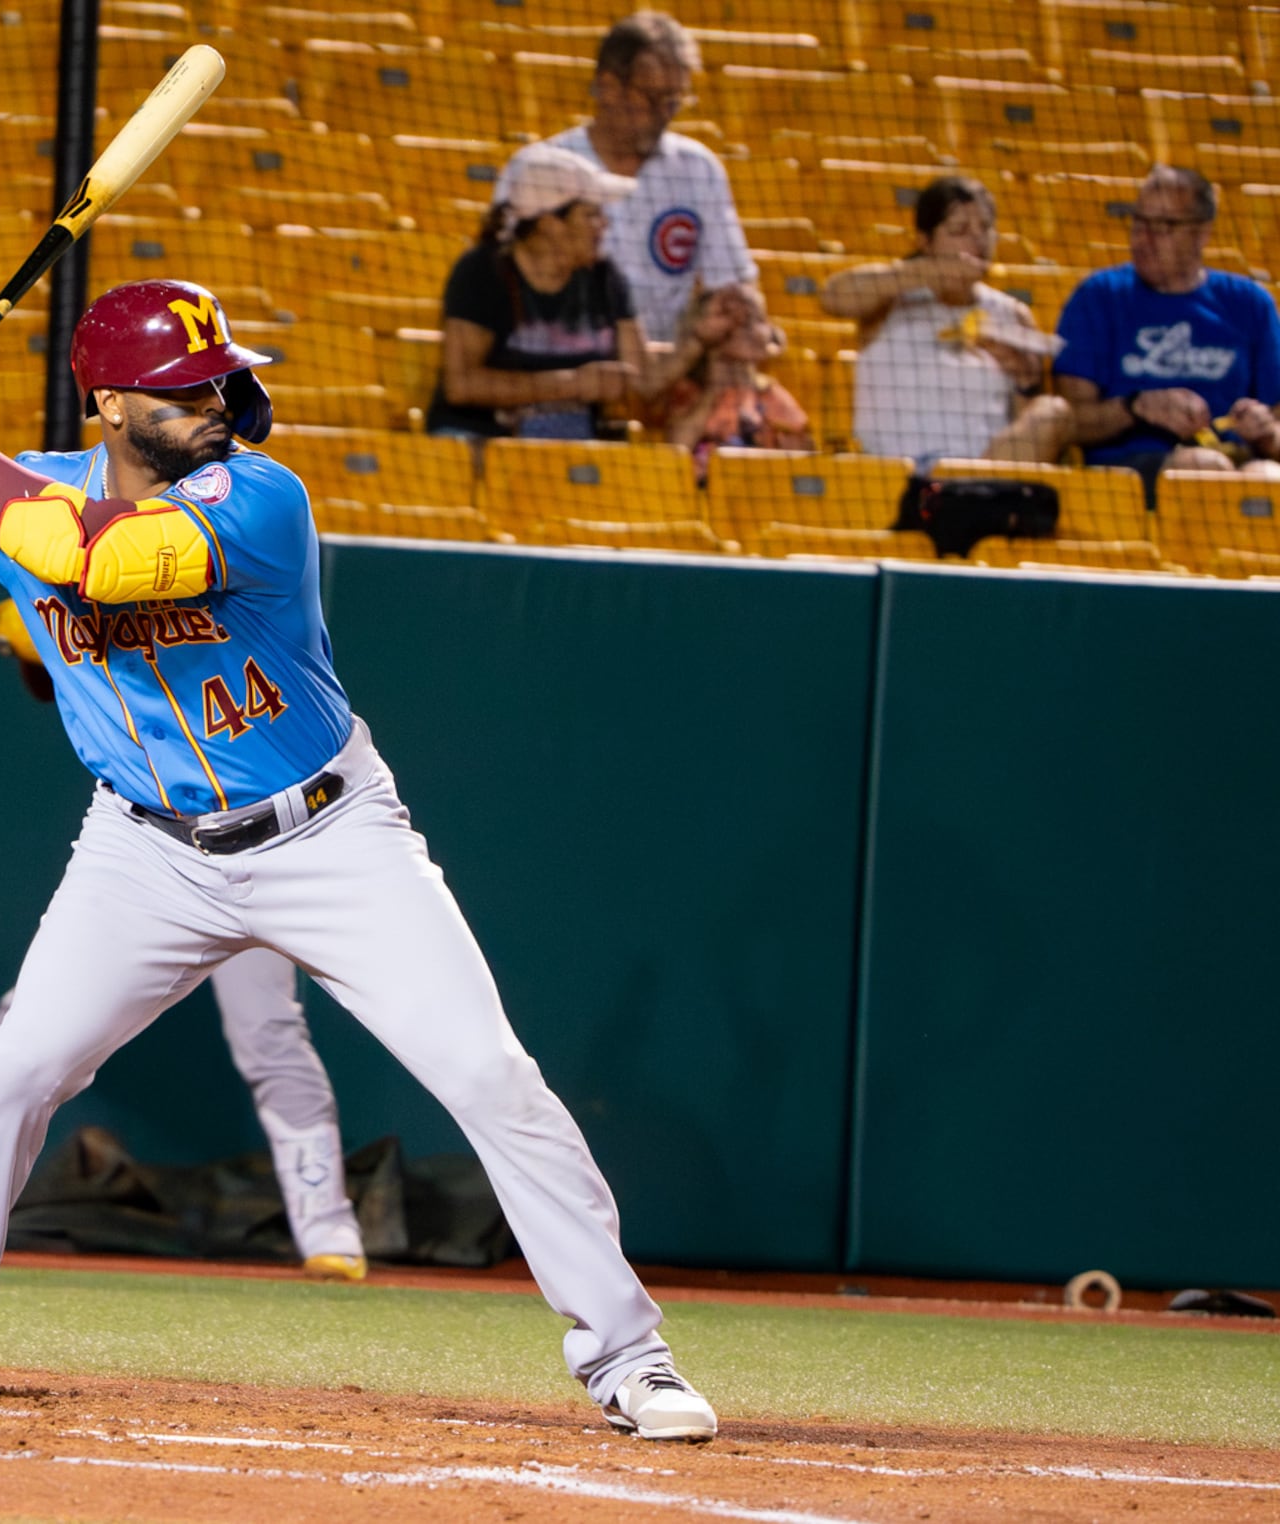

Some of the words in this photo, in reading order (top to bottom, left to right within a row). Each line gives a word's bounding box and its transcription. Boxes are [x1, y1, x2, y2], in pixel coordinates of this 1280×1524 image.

[167, 293, 225, 354] M
[202, 656, 289, 742] 44
[307, 787, 327, 809] 44
